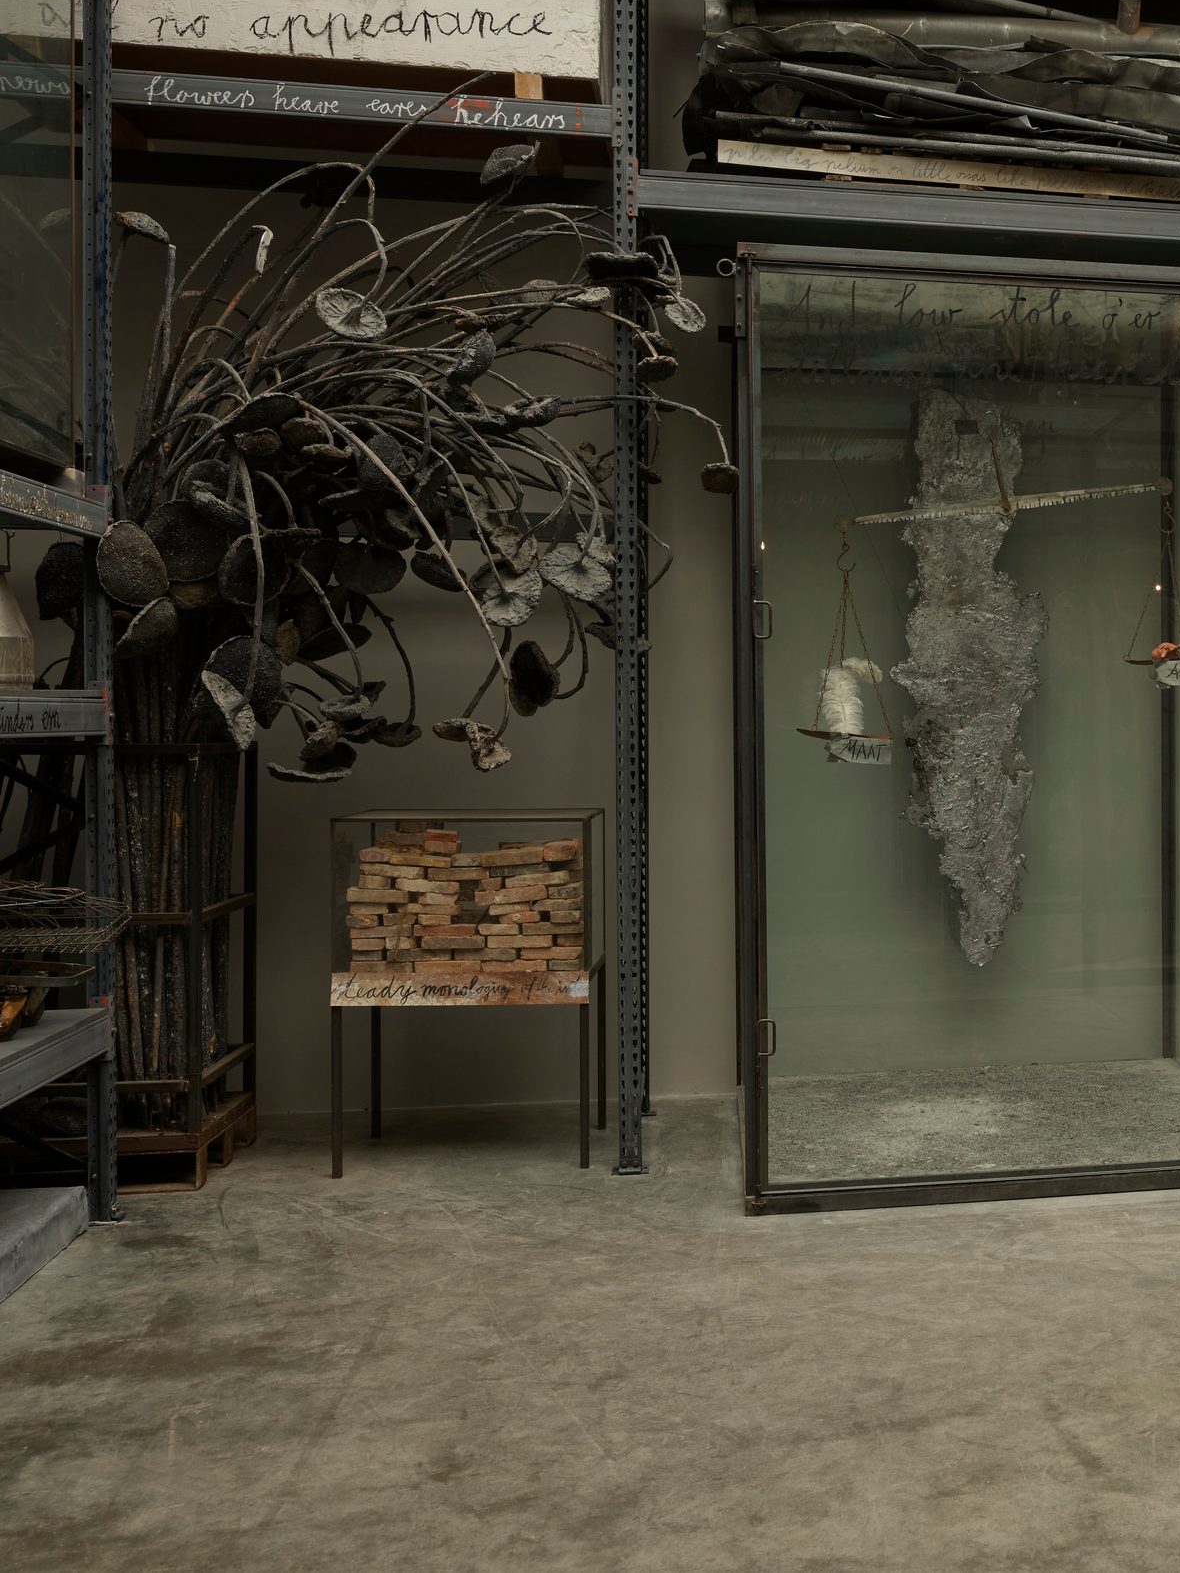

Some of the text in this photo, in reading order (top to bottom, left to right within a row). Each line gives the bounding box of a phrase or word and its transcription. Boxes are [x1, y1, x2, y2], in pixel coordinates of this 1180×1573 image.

[150, 8, 553, 57] no appearance
[912, 160, 951, 182] little
[894, 283, 962, 327] low
[989, 284, 1080, 329] stole
[840, 738, 882, 763] MAAT
